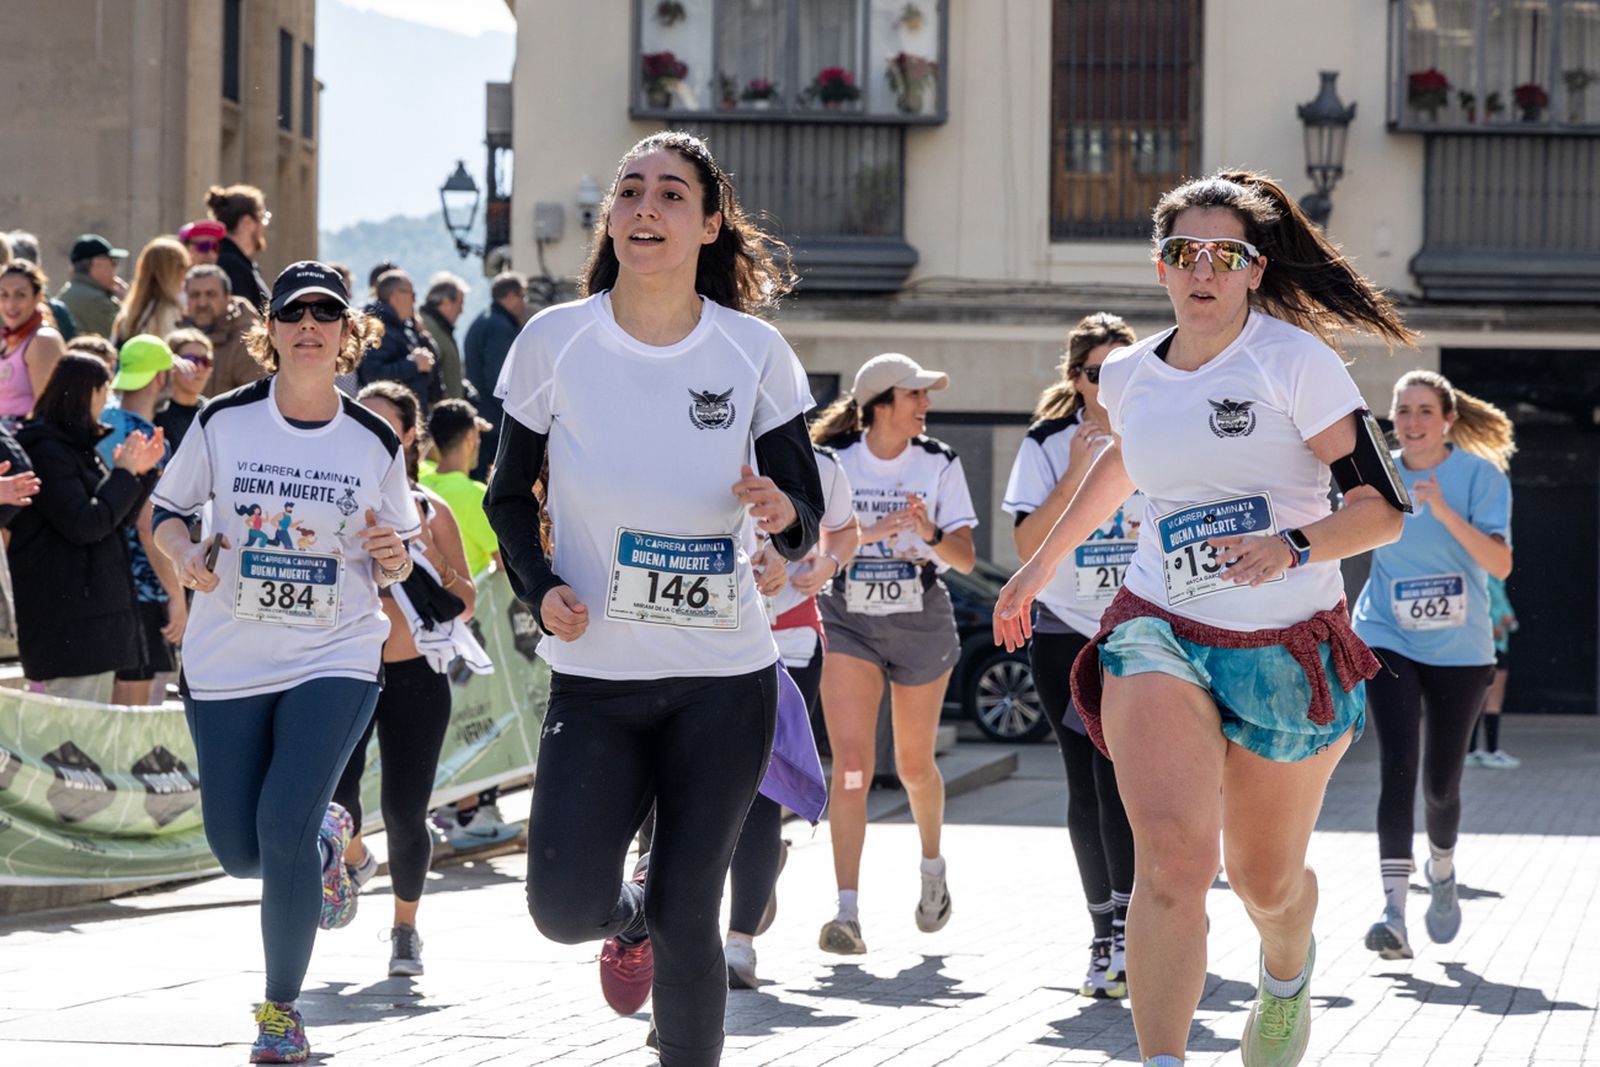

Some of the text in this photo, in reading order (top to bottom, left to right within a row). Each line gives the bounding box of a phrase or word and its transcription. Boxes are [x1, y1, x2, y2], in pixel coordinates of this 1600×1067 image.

[237, 461, 361, 487] VI CARRERA CAMINATA
[232, 477, 336, 504] BUENA MUERTE
[1174, 510, 1208, 526] CARRERA
[1210, 501, 1255, 517] CAMINATA
[1169, 518, 1238, 547] BUENA MUERTE
[634, 536, 726, 553] VI CARRERA CAMINATA
[260, 554, 291, 565] CARRERA
[292, 557, 327, 568] CAMINATA
[631, 549, 710, 571] BUENA MUERTE
[250, 564, 311, 581] BUENA MUERTE
[1096, 567, 1126, 588] 21
[259, 580, 314, 610] 384
[647, 571, 710, 609] 146
[865, 581, 901, 600] 710
[1410, 596, 1451, 619] 662
